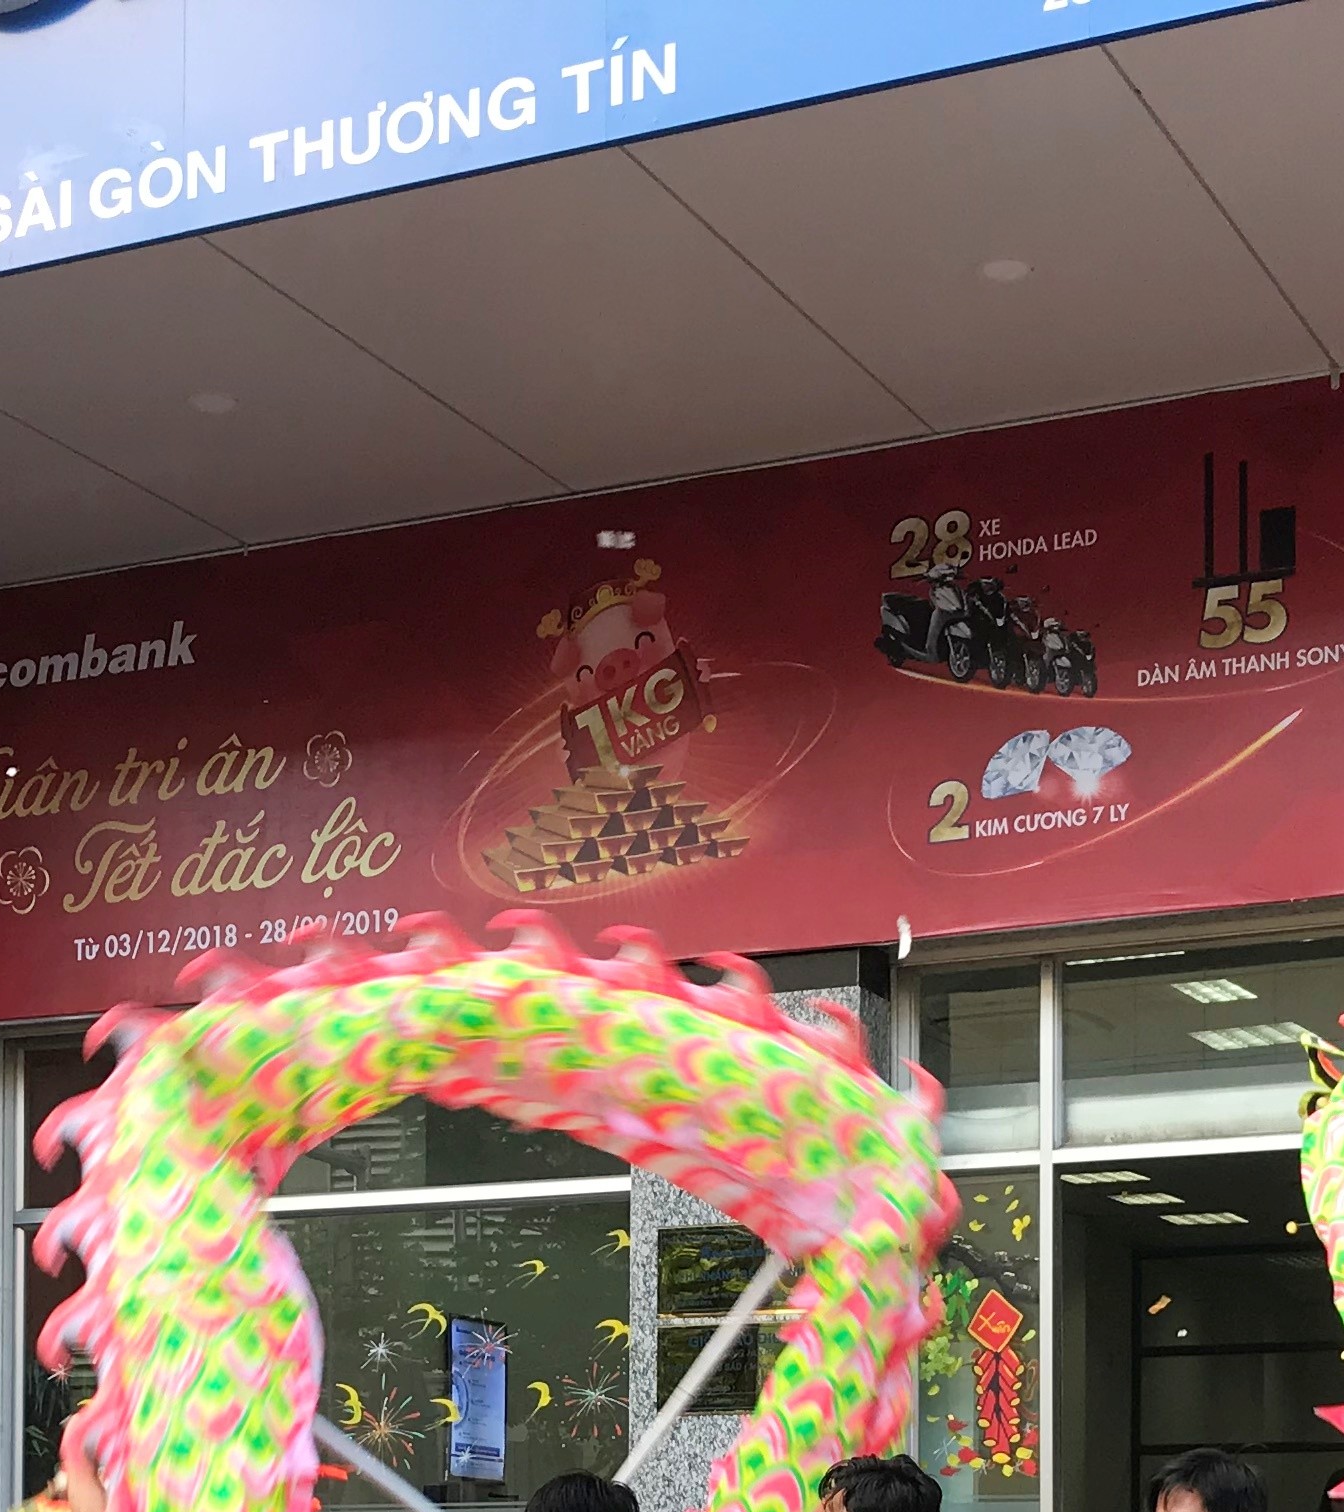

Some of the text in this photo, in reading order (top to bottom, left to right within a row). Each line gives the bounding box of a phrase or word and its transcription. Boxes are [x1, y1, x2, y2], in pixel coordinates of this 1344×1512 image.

[89, 139, 226, 220] GÒN
[249, 77, 536, 183] THƯƠNG
[561, 36, 677, 115] TÍN
[890, 509, 1001, 579] 28 XE
[979, 529, 1097, 561] HONDA LEAD
[1199, 579, 1287, 648] 55
[1137, 663, 1180, 686] DÀN
[1185, 658, 1216, 681] ÂM
[1222, 651, 1289, 676] THANH
[620, 715, 680, 757] VÀNG
[109, 736, 186, 807] tri
[195, 735, 286, 796] ân
[929, 780, 1129, 842] 2 KIM CƯƠNG 7 LY
[63, 797, 402, 913] Tết đắc lộc
[74, 937, 100, 961] Từ
[105, 924, 237, 959] 03/12/2018
